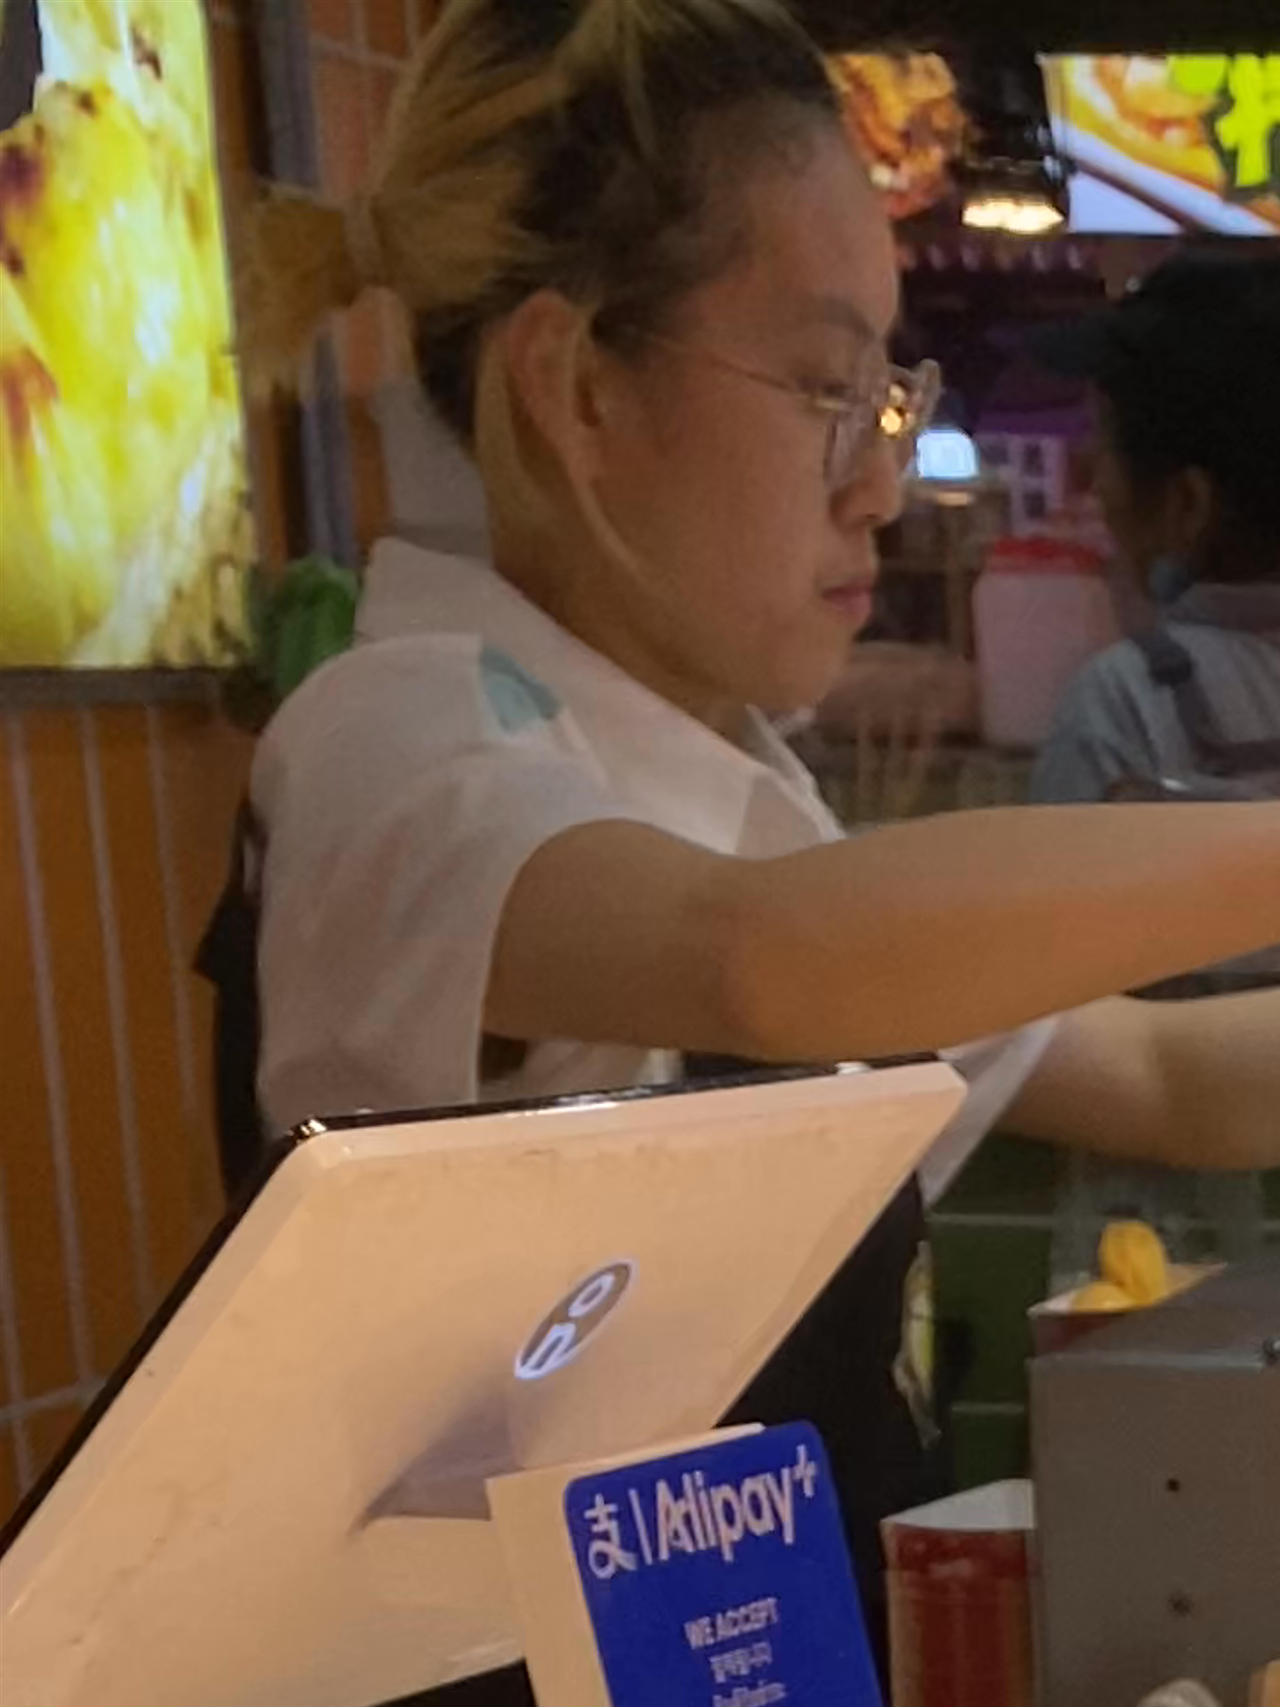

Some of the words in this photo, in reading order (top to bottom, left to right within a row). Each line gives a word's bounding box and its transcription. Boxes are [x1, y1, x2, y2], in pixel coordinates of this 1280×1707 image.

[656, 1443, 818, 1562] Alipay+
[684, 1615, 715, 1650] WE
[715, 1597, 777, 1642] ACCEPT
